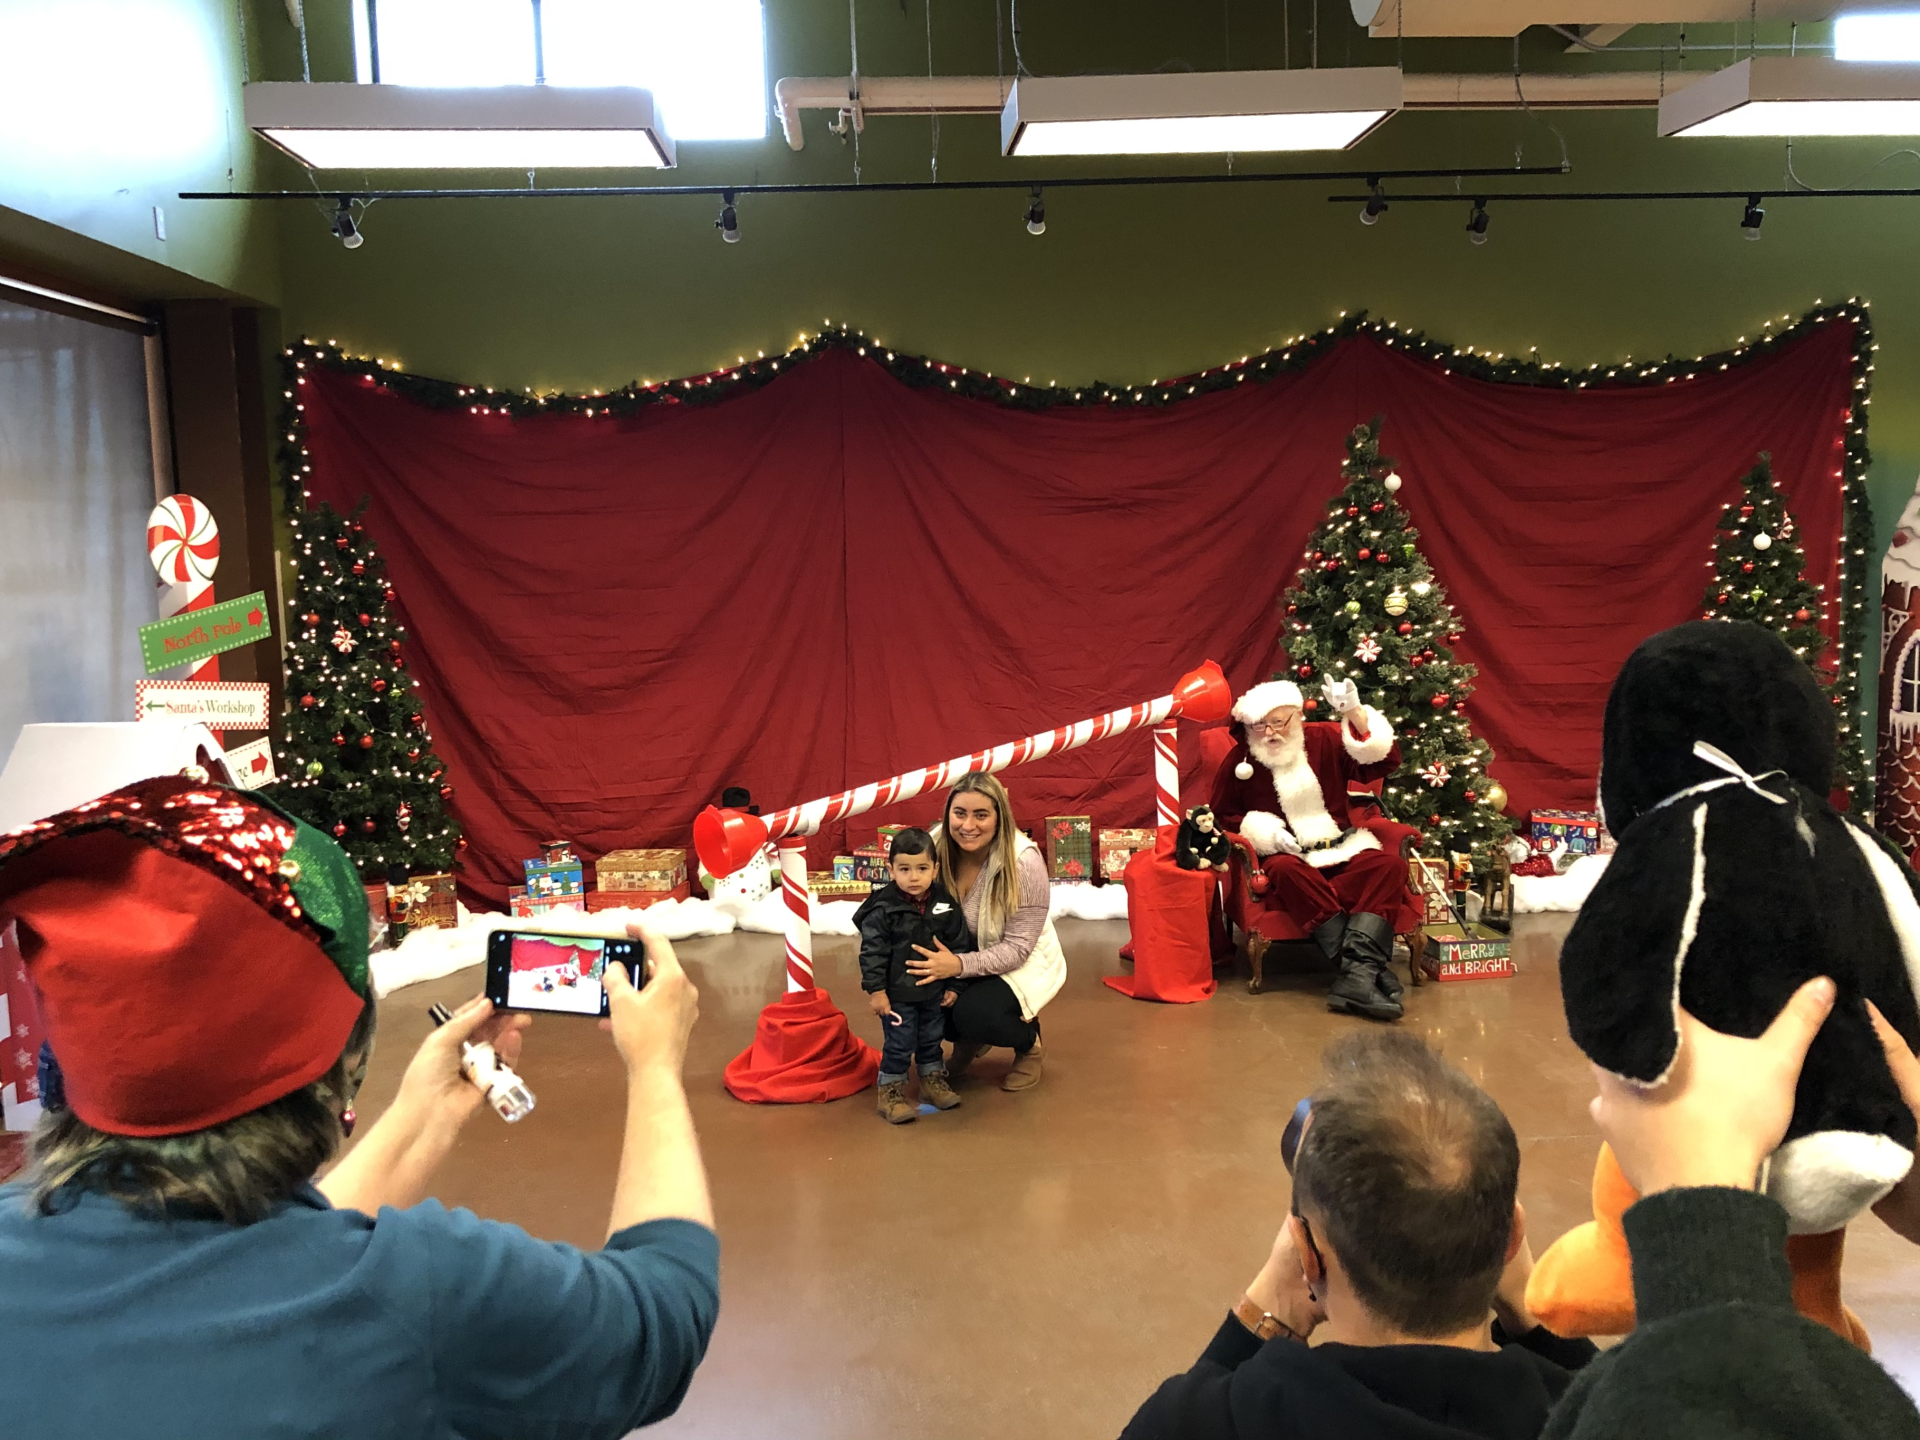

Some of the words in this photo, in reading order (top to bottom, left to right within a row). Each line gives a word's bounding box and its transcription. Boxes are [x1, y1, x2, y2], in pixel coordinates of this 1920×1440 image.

[163, 626, 210, 654] North
[213, 616, 242, 639] Pole
[166, 700, 204, 714] Santa's
[205, 700, 256, 717] Workshop
[857, 866, 889, 881] CHRISTM
